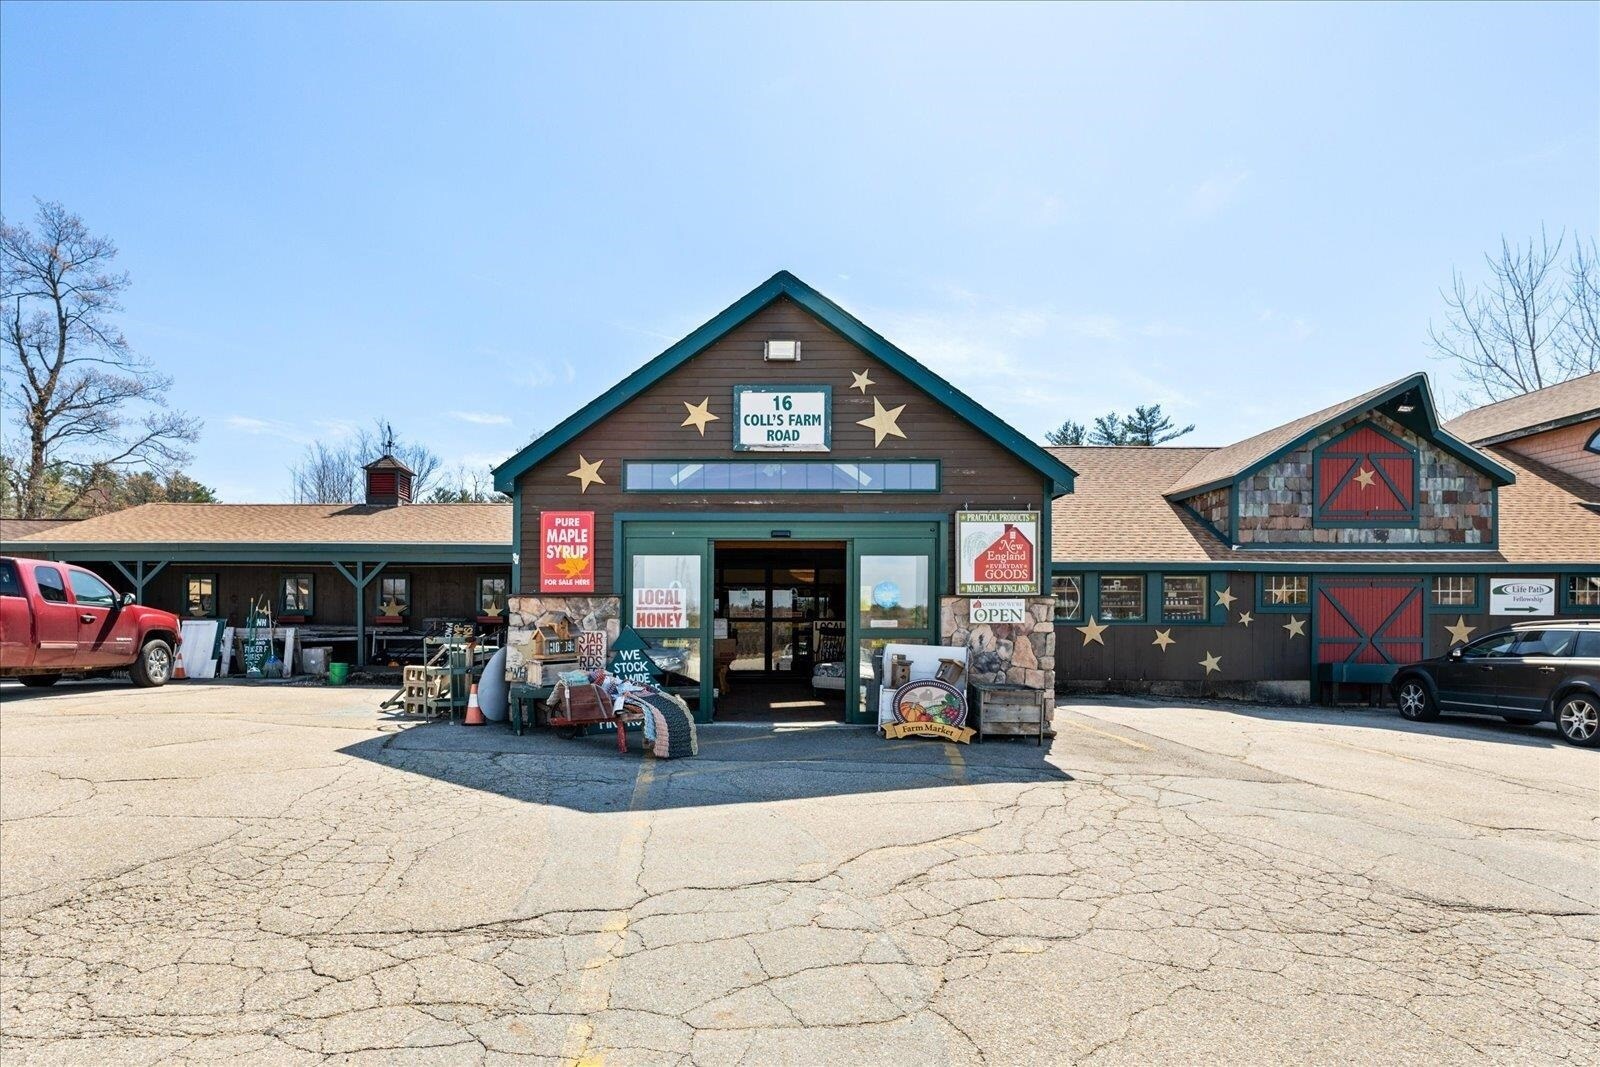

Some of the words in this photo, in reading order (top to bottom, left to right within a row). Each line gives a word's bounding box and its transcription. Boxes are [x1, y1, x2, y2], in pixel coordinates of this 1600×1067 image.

[773, 395, 792, 411] 16
[743, 414, 784, 426] COLL'S
[788, 414, 821, 426] FARM
[767, 430, 800, 441] ROAD
[555, 518, 580, 526] PURE
[966, 513, 998, 521] PRACTICAL
[1000, 513, 1030, 521] PRODUCTS
[547, 529, 588, 543] MAPLE
[547, 545, 588, 559] SYRUP
[999, 540, 1024, 554] New
[987, 551, 1026, 564] England
[985, 569, 1029, 580] GOODS
[638, 590, 681, 605] LOCAL
[636, 613, 682, 627] HONEY
[974, 609, 1023, 622] OPEN
[620, 650, 641, 660] WE
[614, 661, 649, 674] STOCK
[902, 725, 924, 733] Farm
[924, 724, 954, 737] Market
